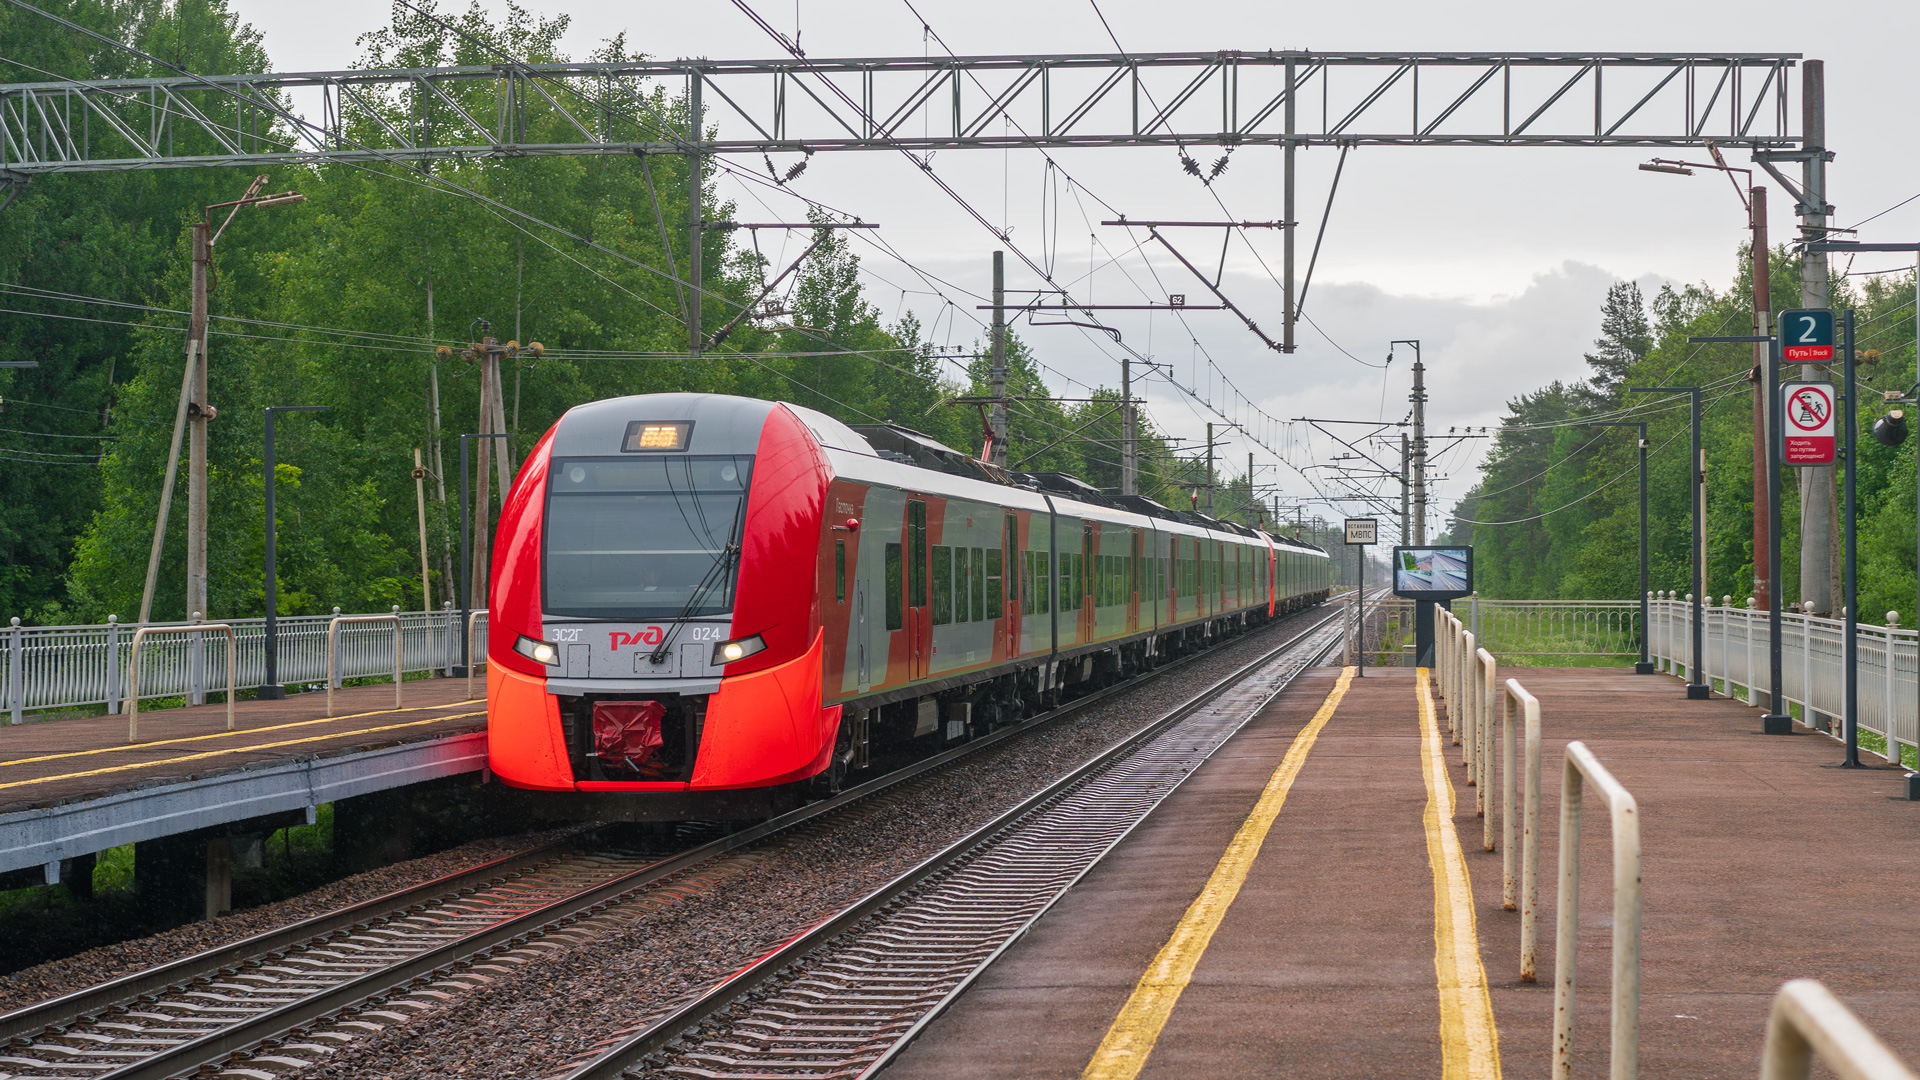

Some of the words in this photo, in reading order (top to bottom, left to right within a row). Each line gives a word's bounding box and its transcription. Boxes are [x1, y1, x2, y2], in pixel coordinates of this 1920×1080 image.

[1172, 296, 1183, 304] 62
[1799, 315, 1817, 343] 2
[1789, 349, 1809, 358] Путь
[1350, 530, 1372, 539] МВПС
[692, 627, 721, 641] 024
